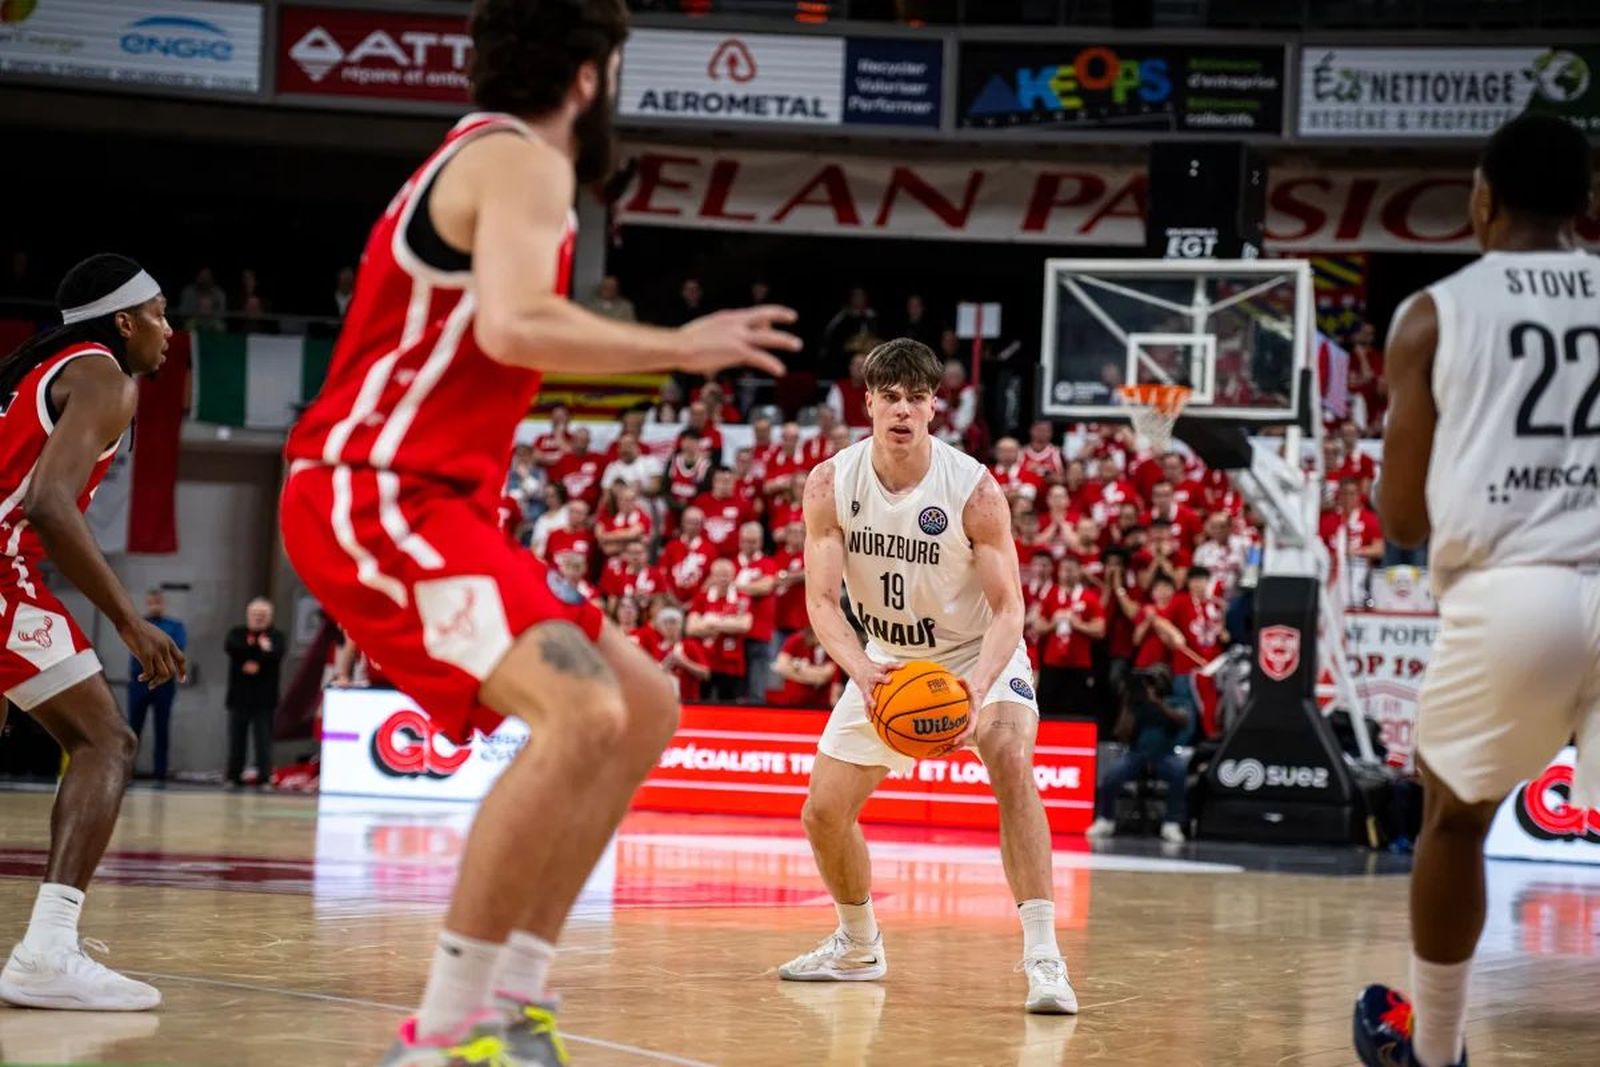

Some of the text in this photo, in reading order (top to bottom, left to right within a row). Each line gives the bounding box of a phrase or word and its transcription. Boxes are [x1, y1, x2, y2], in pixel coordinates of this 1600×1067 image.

[1015, 45, 1173, 109] KEOPS
[1368, 72, 1515, 104] NETTOYAGE
[637, 88, 828, 119] AEROMETAL
[626, 153, 986, 230] ELAN
[1505, 267, 1596, 300] STOVE
[1509, 320, 1600, 438] 22
[849, 527, 940, 565] WÜRZBURG
[880, 571, 905, 611] 19
[857, 601, 937, 648] KNAUF
[912, 713, 968, 735] Wilson
[918, 759, 946, 782] ET
